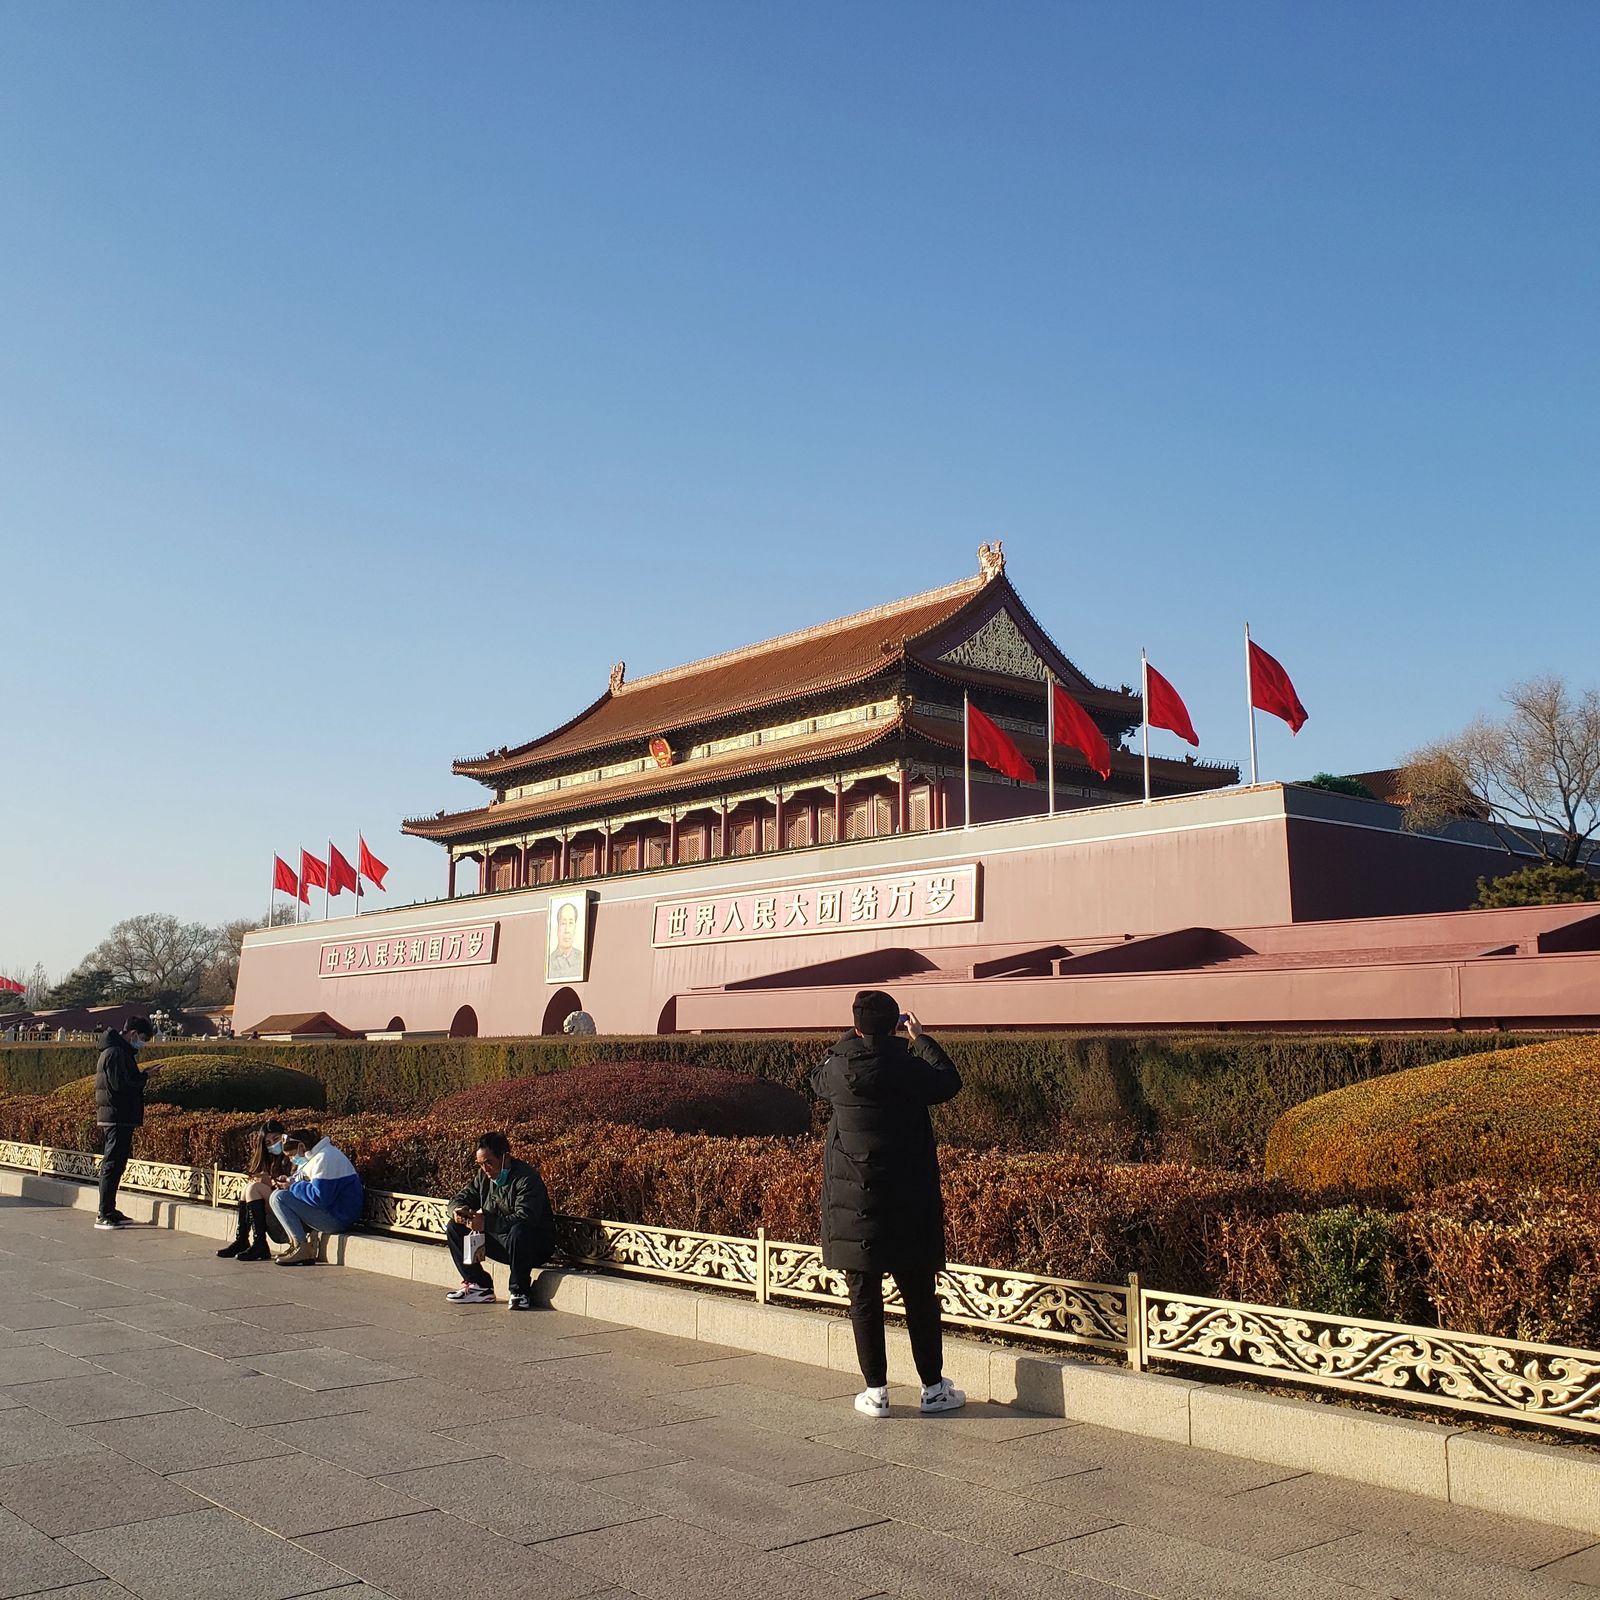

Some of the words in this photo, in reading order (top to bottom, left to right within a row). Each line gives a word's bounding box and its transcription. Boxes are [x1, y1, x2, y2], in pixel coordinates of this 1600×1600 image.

[667, 877, 955, 938] 世界人民大团结万岁
[327, 932, 485, 971] 中华人民共和国万岁
